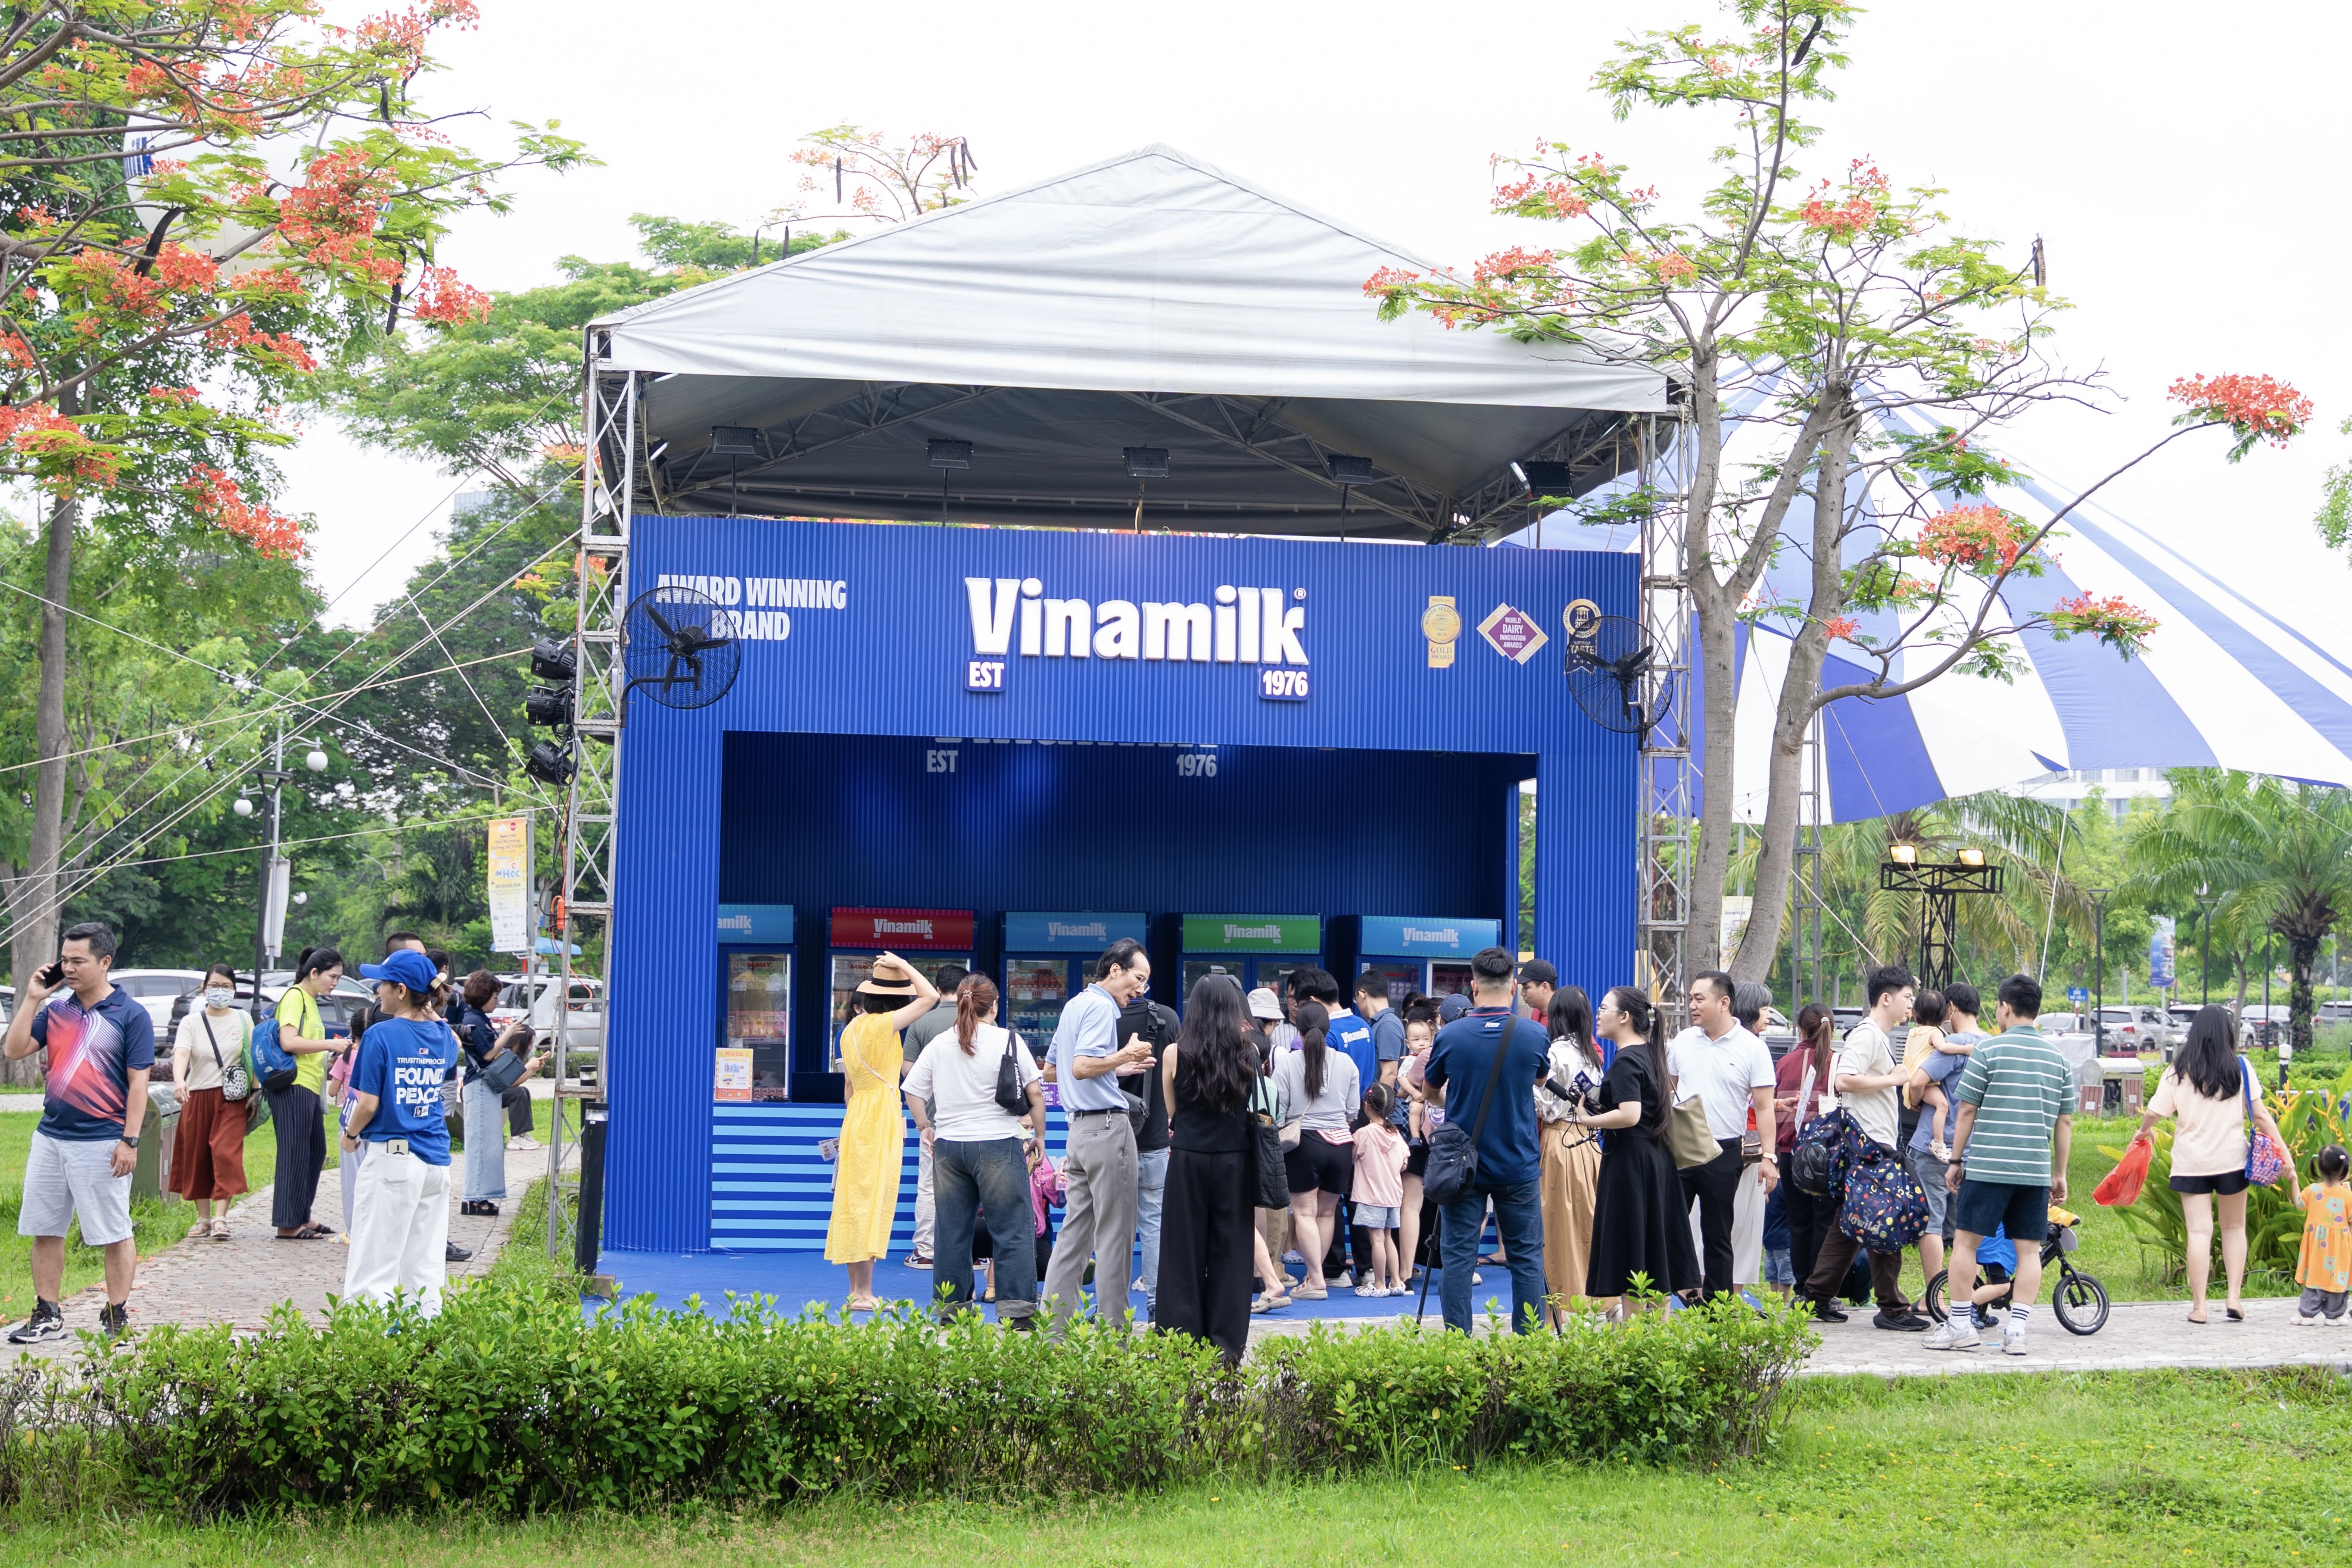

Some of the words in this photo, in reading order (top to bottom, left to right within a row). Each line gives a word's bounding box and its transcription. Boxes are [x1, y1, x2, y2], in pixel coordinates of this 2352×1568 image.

[656, 575, 741, 606] AWARD
[746, 577, 846, 609] WINNING
[711, 610, 790, 640] BRAND
[1424, 608, 1437, 625] MONDE
[1438, 606, 1459, 626] SELECTION
[1503, 624, 1524, 634] DAIRY
[1517, 643, 1537, 661] WINNER
[968, 661, 1005, 687] EST
[1263, 670, 1308, 696] 1976
[927, 749, 958, 772] EST
[1176, 754, 1217, 777] 1976
[874, 918, 933, 933] Vinamilk
[1048, 922, 1106, 936] Vinamilk
[1223, 924, 1281, 938] Vinamilk
[1403, 927, 1459, 942] Vinamilk
[395, 1067, 444, 1085] FOUND
[396, 1087, 441, 1105] PEACE
